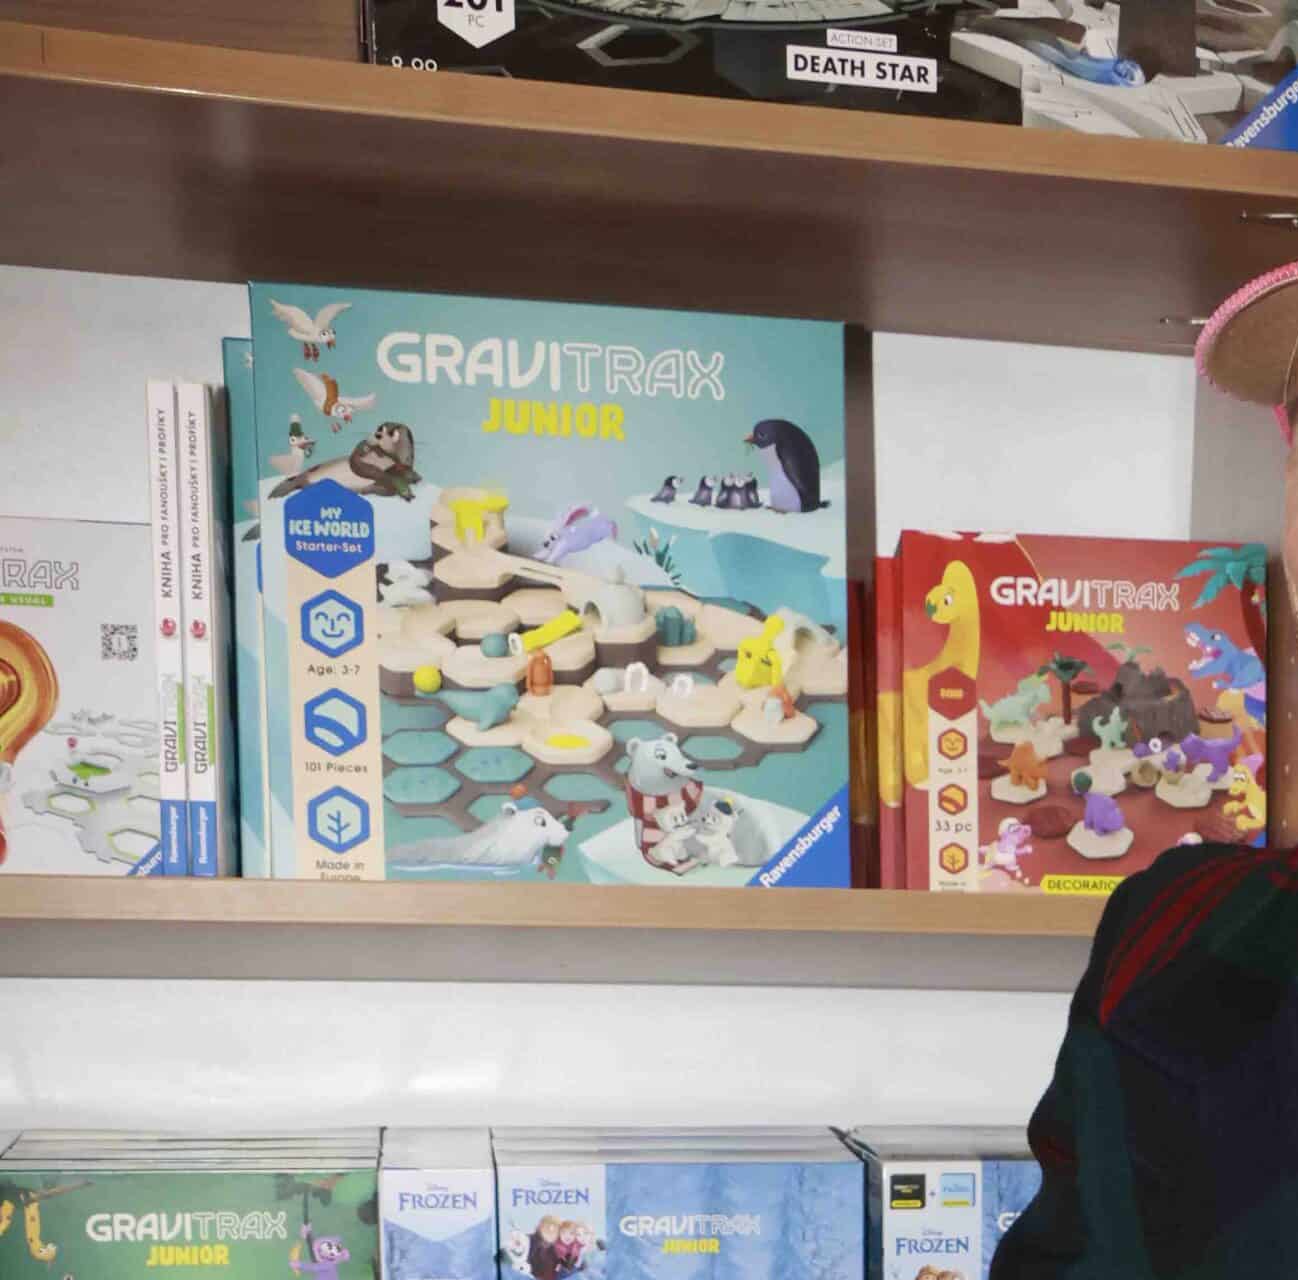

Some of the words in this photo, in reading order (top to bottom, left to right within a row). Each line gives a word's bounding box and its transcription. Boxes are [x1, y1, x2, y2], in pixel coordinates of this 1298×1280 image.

[793, 52, 866, 80] DEATH
[875, 62, 930, 85] STAR
[377, 331, 725, 402] GRAVITRAX
[481, 397, 625, 442] JUNIOR
[155, 464, 169, 522] FANOUŠKY
[187, 466, 199, 524] FANOUŠKY
[320, 507, 343, 520] MY
[160, 524, 170, 547] PRO
[190, 526, 200, 549] PRO
[289, 520, 313, 536] ICE
[316, 521, 370, 539] WORLD
[295, 540, 363, 554] Starter-Set
[160, 551, 173, 599] KNIHA
[190, 552, 204, 600] KNIHA
[989, 576, 1180, 611] GRAVITRAX
[1045, 611, 1125, 634] JUNIOR
[307, 664, 336, 677] Age:
[342, 664, 361, 675] 3-7
[305, 761, 322, 773] 101
[325, 761, 368, 774] Pieces
[935, 820, 950, 832] 33
[954, 821, 973, 834] pc
[758, 804, 843, 886] Ravensburger
[315, 859, 350, 871] Made
[354, 860, 364, 871] in
[1047, 878, 1119, 893] DECORATIO
[398, 1191, 478, 1211] FROZEN
[512, 1186, 591, 1208] FROZEN
[86, 1211, 288, 1243] GRAVITRAX
[619, 1213, 761, 1238] GRAVITRAX
[146, 1244, 231, 1267] JUNIOR
[662, 1237, 720, 1254] JUNIOR
[896, 1236, 969, 1256] FROZEN
